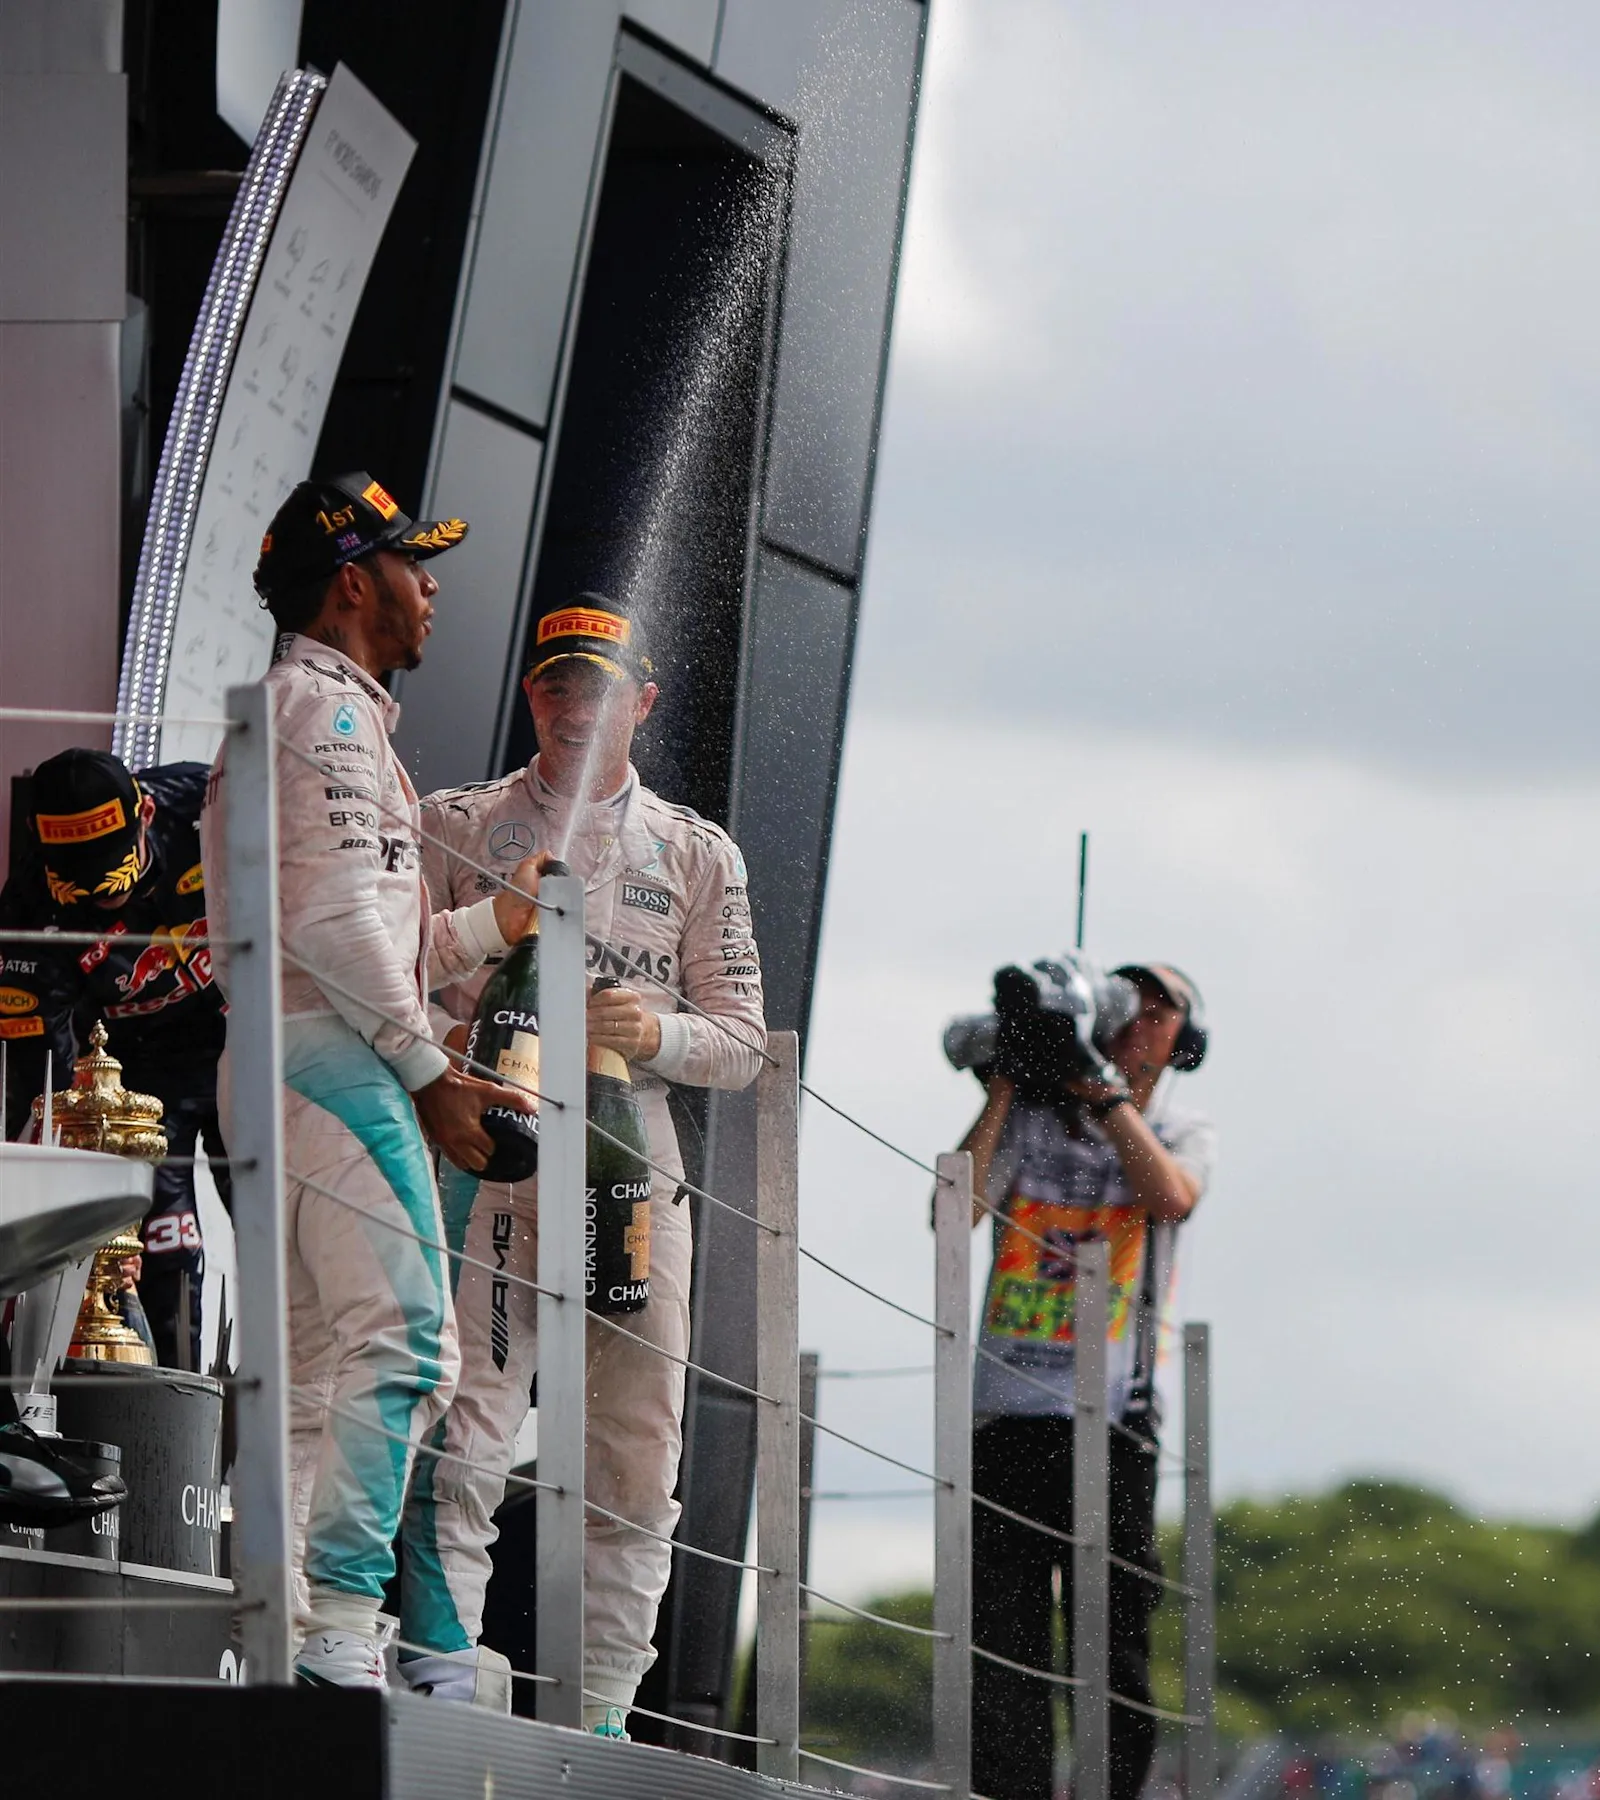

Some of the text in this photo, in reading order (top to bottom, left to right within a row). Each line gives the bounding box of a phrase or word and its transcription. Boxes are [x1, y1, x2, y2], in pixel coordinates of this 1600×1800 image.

[315, 505, 356, 535] 1ST
[542, 613, 624, 638] PIRELLI
[42, 806, 120, 839] PIRELLI
[625, 886, 670, 909] BOSS
[5, 960, 38, 974] AT&T
[104, 966, 199, 1019] Red
[146, 1211, 202, 1252] 33
[584, 1186, 598, 1297] CHANDON
